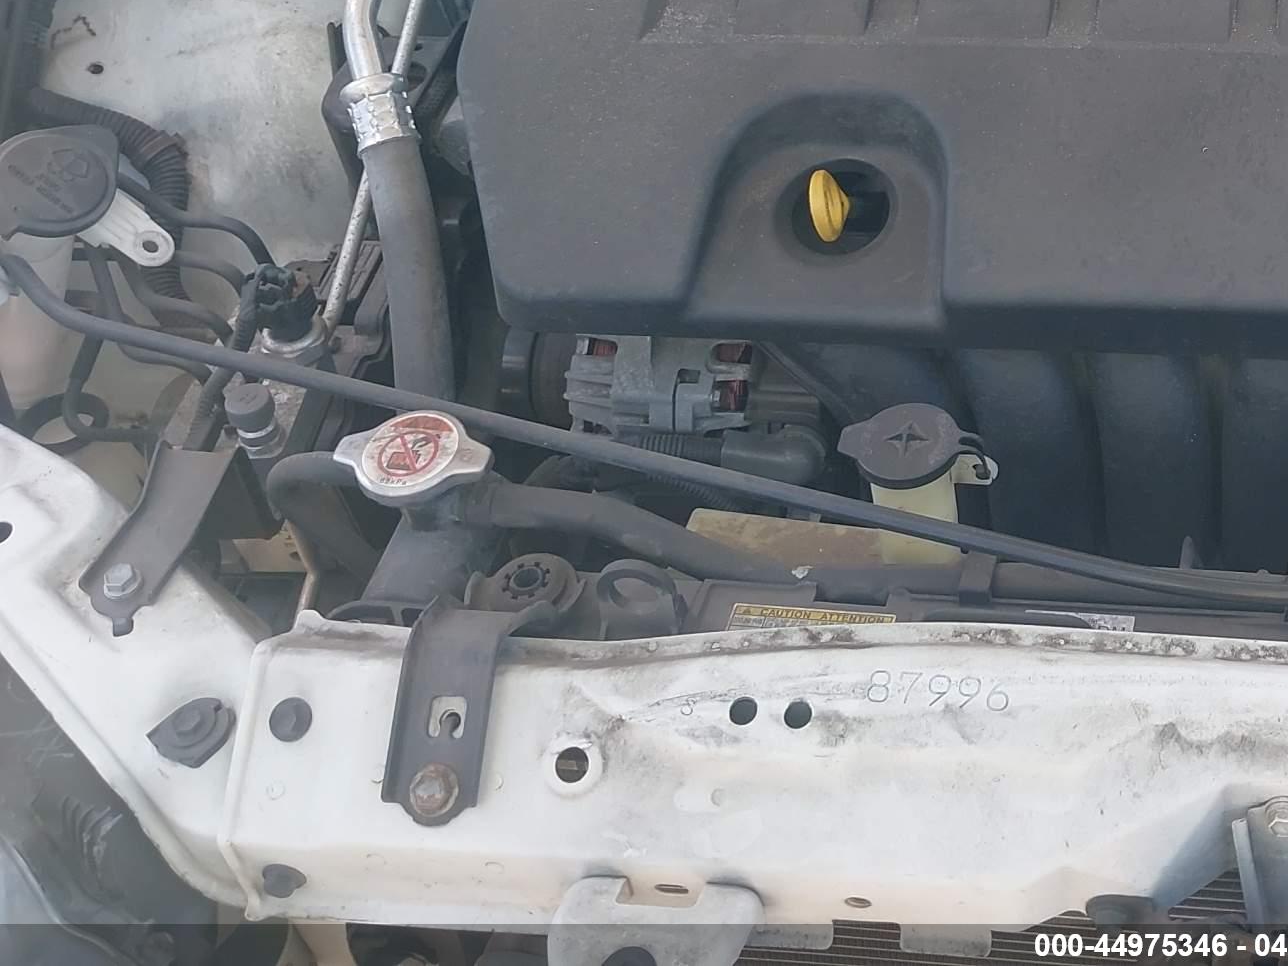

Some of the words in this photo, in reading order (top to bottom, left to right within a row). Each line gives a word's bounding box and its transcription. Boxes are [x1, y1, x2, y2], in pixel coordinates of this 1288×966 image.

[760, 608, 812, 619] CAUTION
[820, 614, 885, 624] ATTENTION
[866, 669, 1010, 712] 87996
